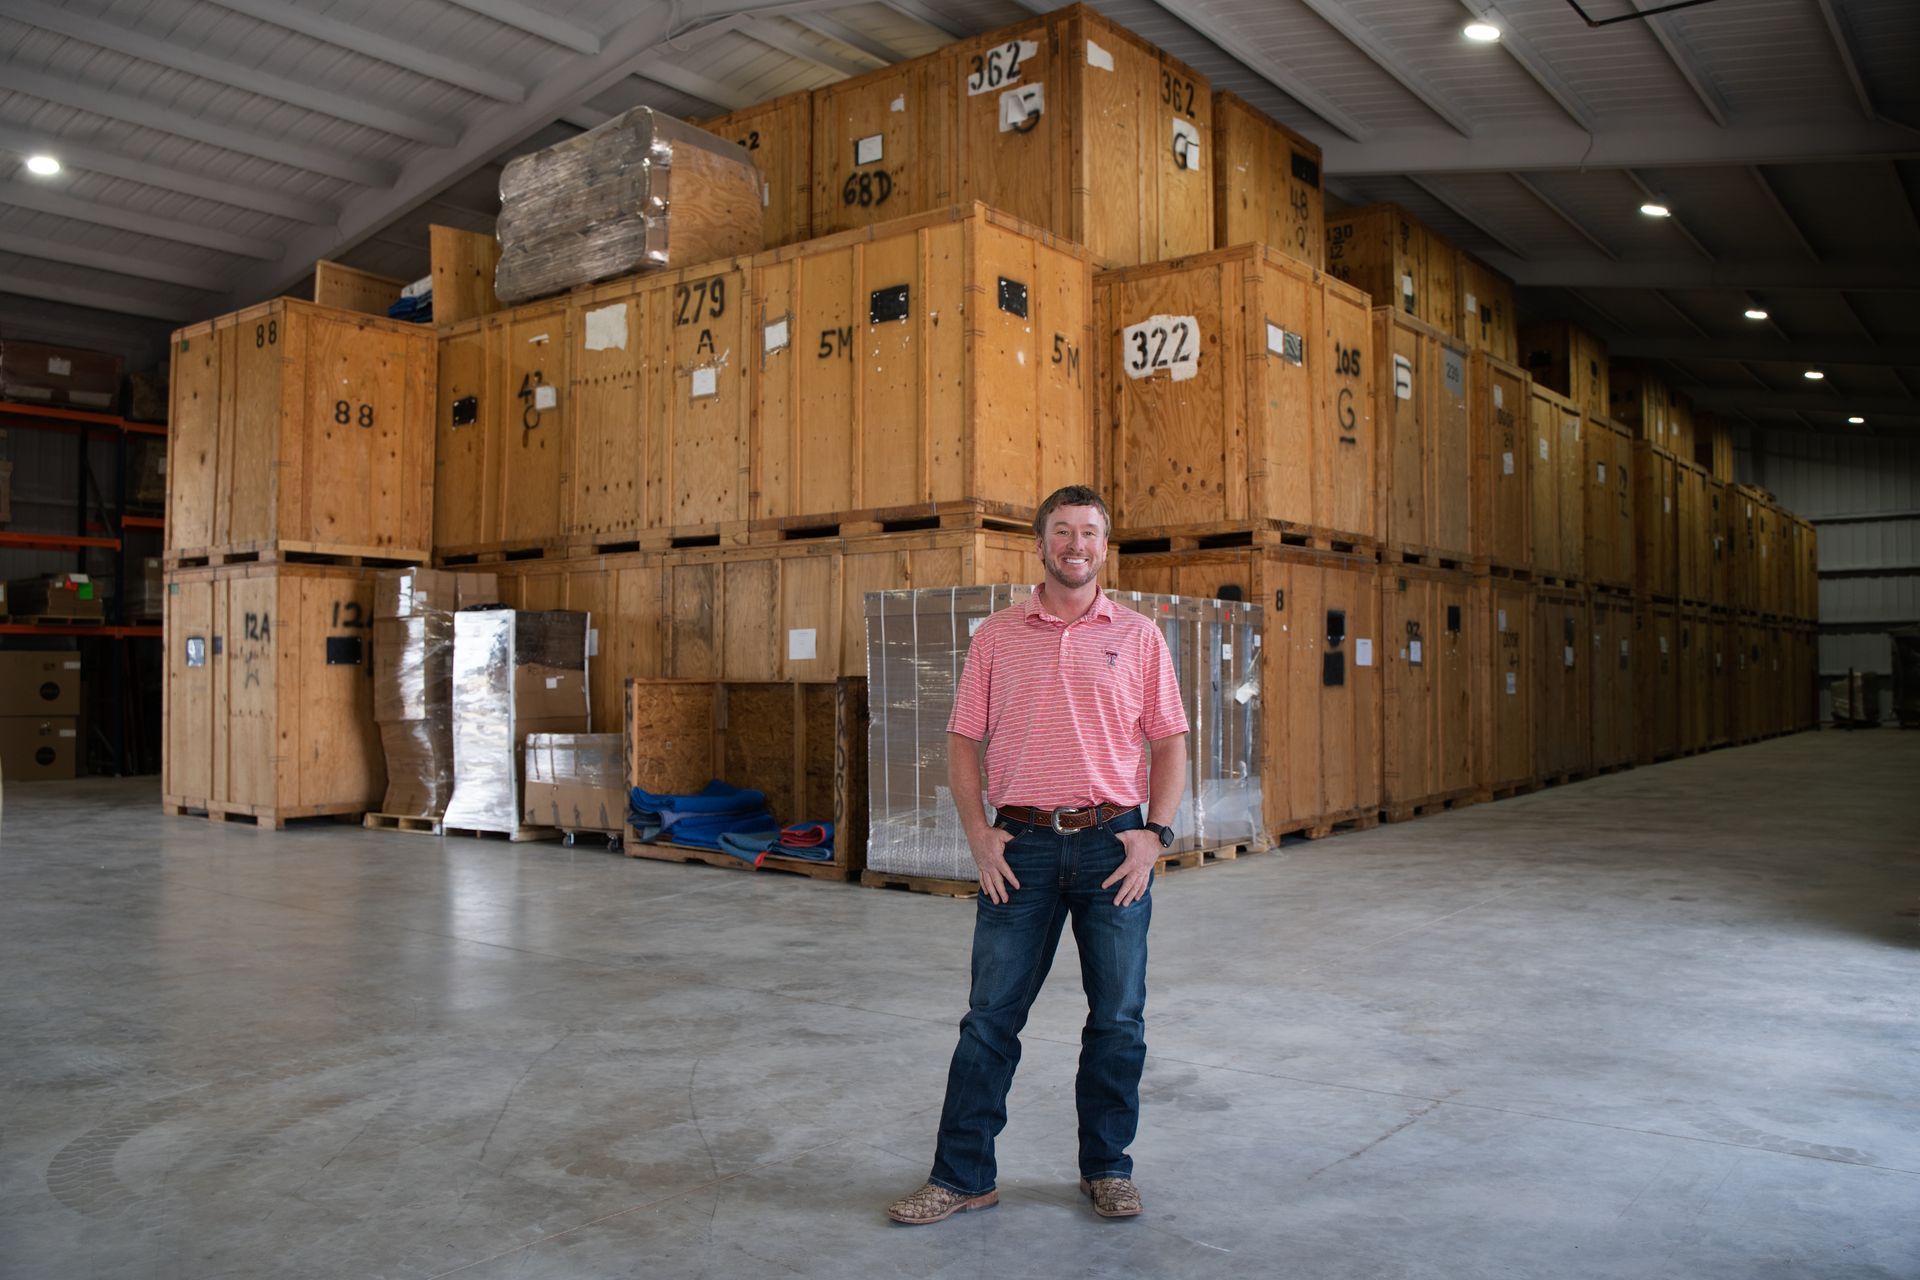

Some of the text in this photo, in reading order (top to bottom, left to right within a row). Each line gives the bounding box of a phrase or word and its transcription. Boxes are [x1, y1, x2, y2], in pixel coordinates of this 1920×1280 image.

[971, 42, 1021, 89] 362
[1161, 69, 1195, 117] 362
[842, 171, 891, 206] 68D
[676, 277, 724, 326] 279
[256, 320, 277, 348] 88
[697, 328, 714, 354] A
[817, 326, 853, 363] 5M
[1131, 322, 1190, 370] 322
[1052, 333, 1081, 389] 5M
[1395, 359, 1412, 413] F
[335, 400, 374, 428] 88
[1337, 388, 1355, 430] G
[331, 601, 374, 630] 12
[1276, 589, 1284, 611] 8
[244, 612, 271, 642] 12A
